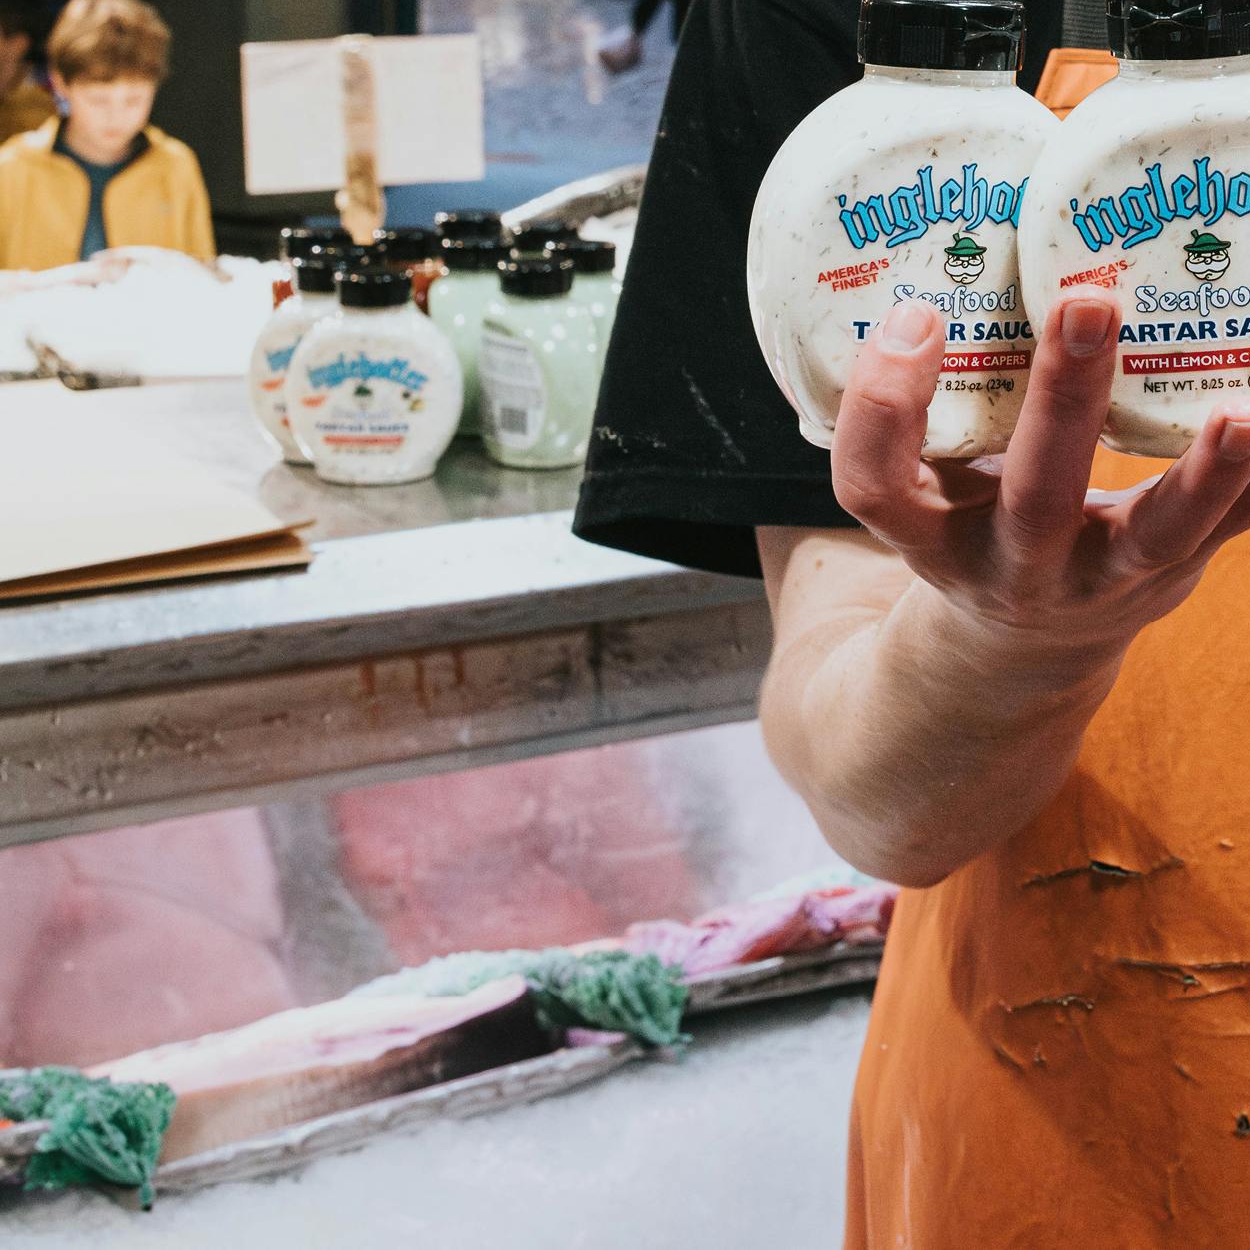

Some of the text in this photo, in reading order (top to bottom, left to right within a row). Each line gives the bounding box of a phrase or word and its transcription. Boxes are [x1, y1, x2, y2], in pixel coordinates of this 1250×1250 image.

[817, 258, 890, 284] AMERICA'S
[1060, 259, 1128, 288] AMERICA'S
[832, 272, 879, 293] FINEST
[973, 321, 1034, 341] SAUC
[1117, 320, 1218, 344] ARTAR
[971, 356, 980, 367] &
[983, 354, 1026, 367] CAPERS
[1129, 357, 1170, 370] WITH
[1173, 354, 1224, 368] LEMON
[1226, 354, 1237, 365] &
[945, 380, 966, 391] 8.25
[1144, 381, 1166, 394] NET
[1171, 379, 1199, 393] WT.
[1201, 378, 1225, 391] 8.25
[1228, 378, 1245, 388] oz.
